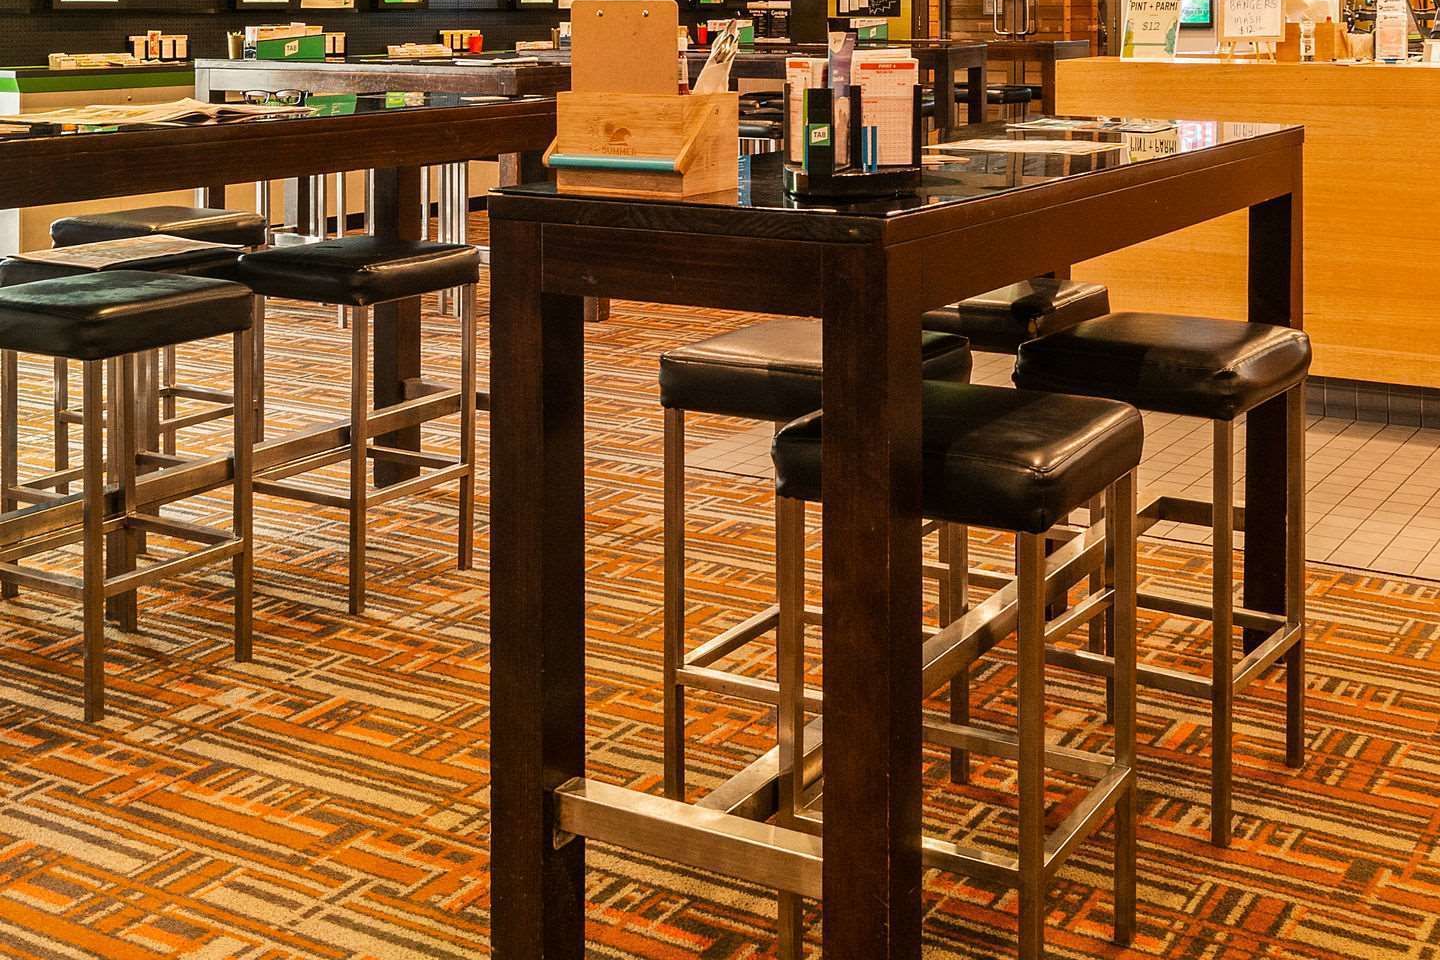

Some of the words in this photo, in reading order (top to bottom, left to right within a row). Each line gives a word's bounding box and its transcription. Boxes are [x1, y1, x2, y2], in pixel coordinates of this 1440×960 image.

[1130, 1, 1147, 11] PINT
[1155, 0, 1178, 10] PARMI
[1229, 0, 1278, 10] BANGERS
[1234, 16, 1262, 24] MASH
[1142, 21, 1161, 31] $12
[286, 44, 297, 52] TAB
[813, 130, 826, 138] TAB
